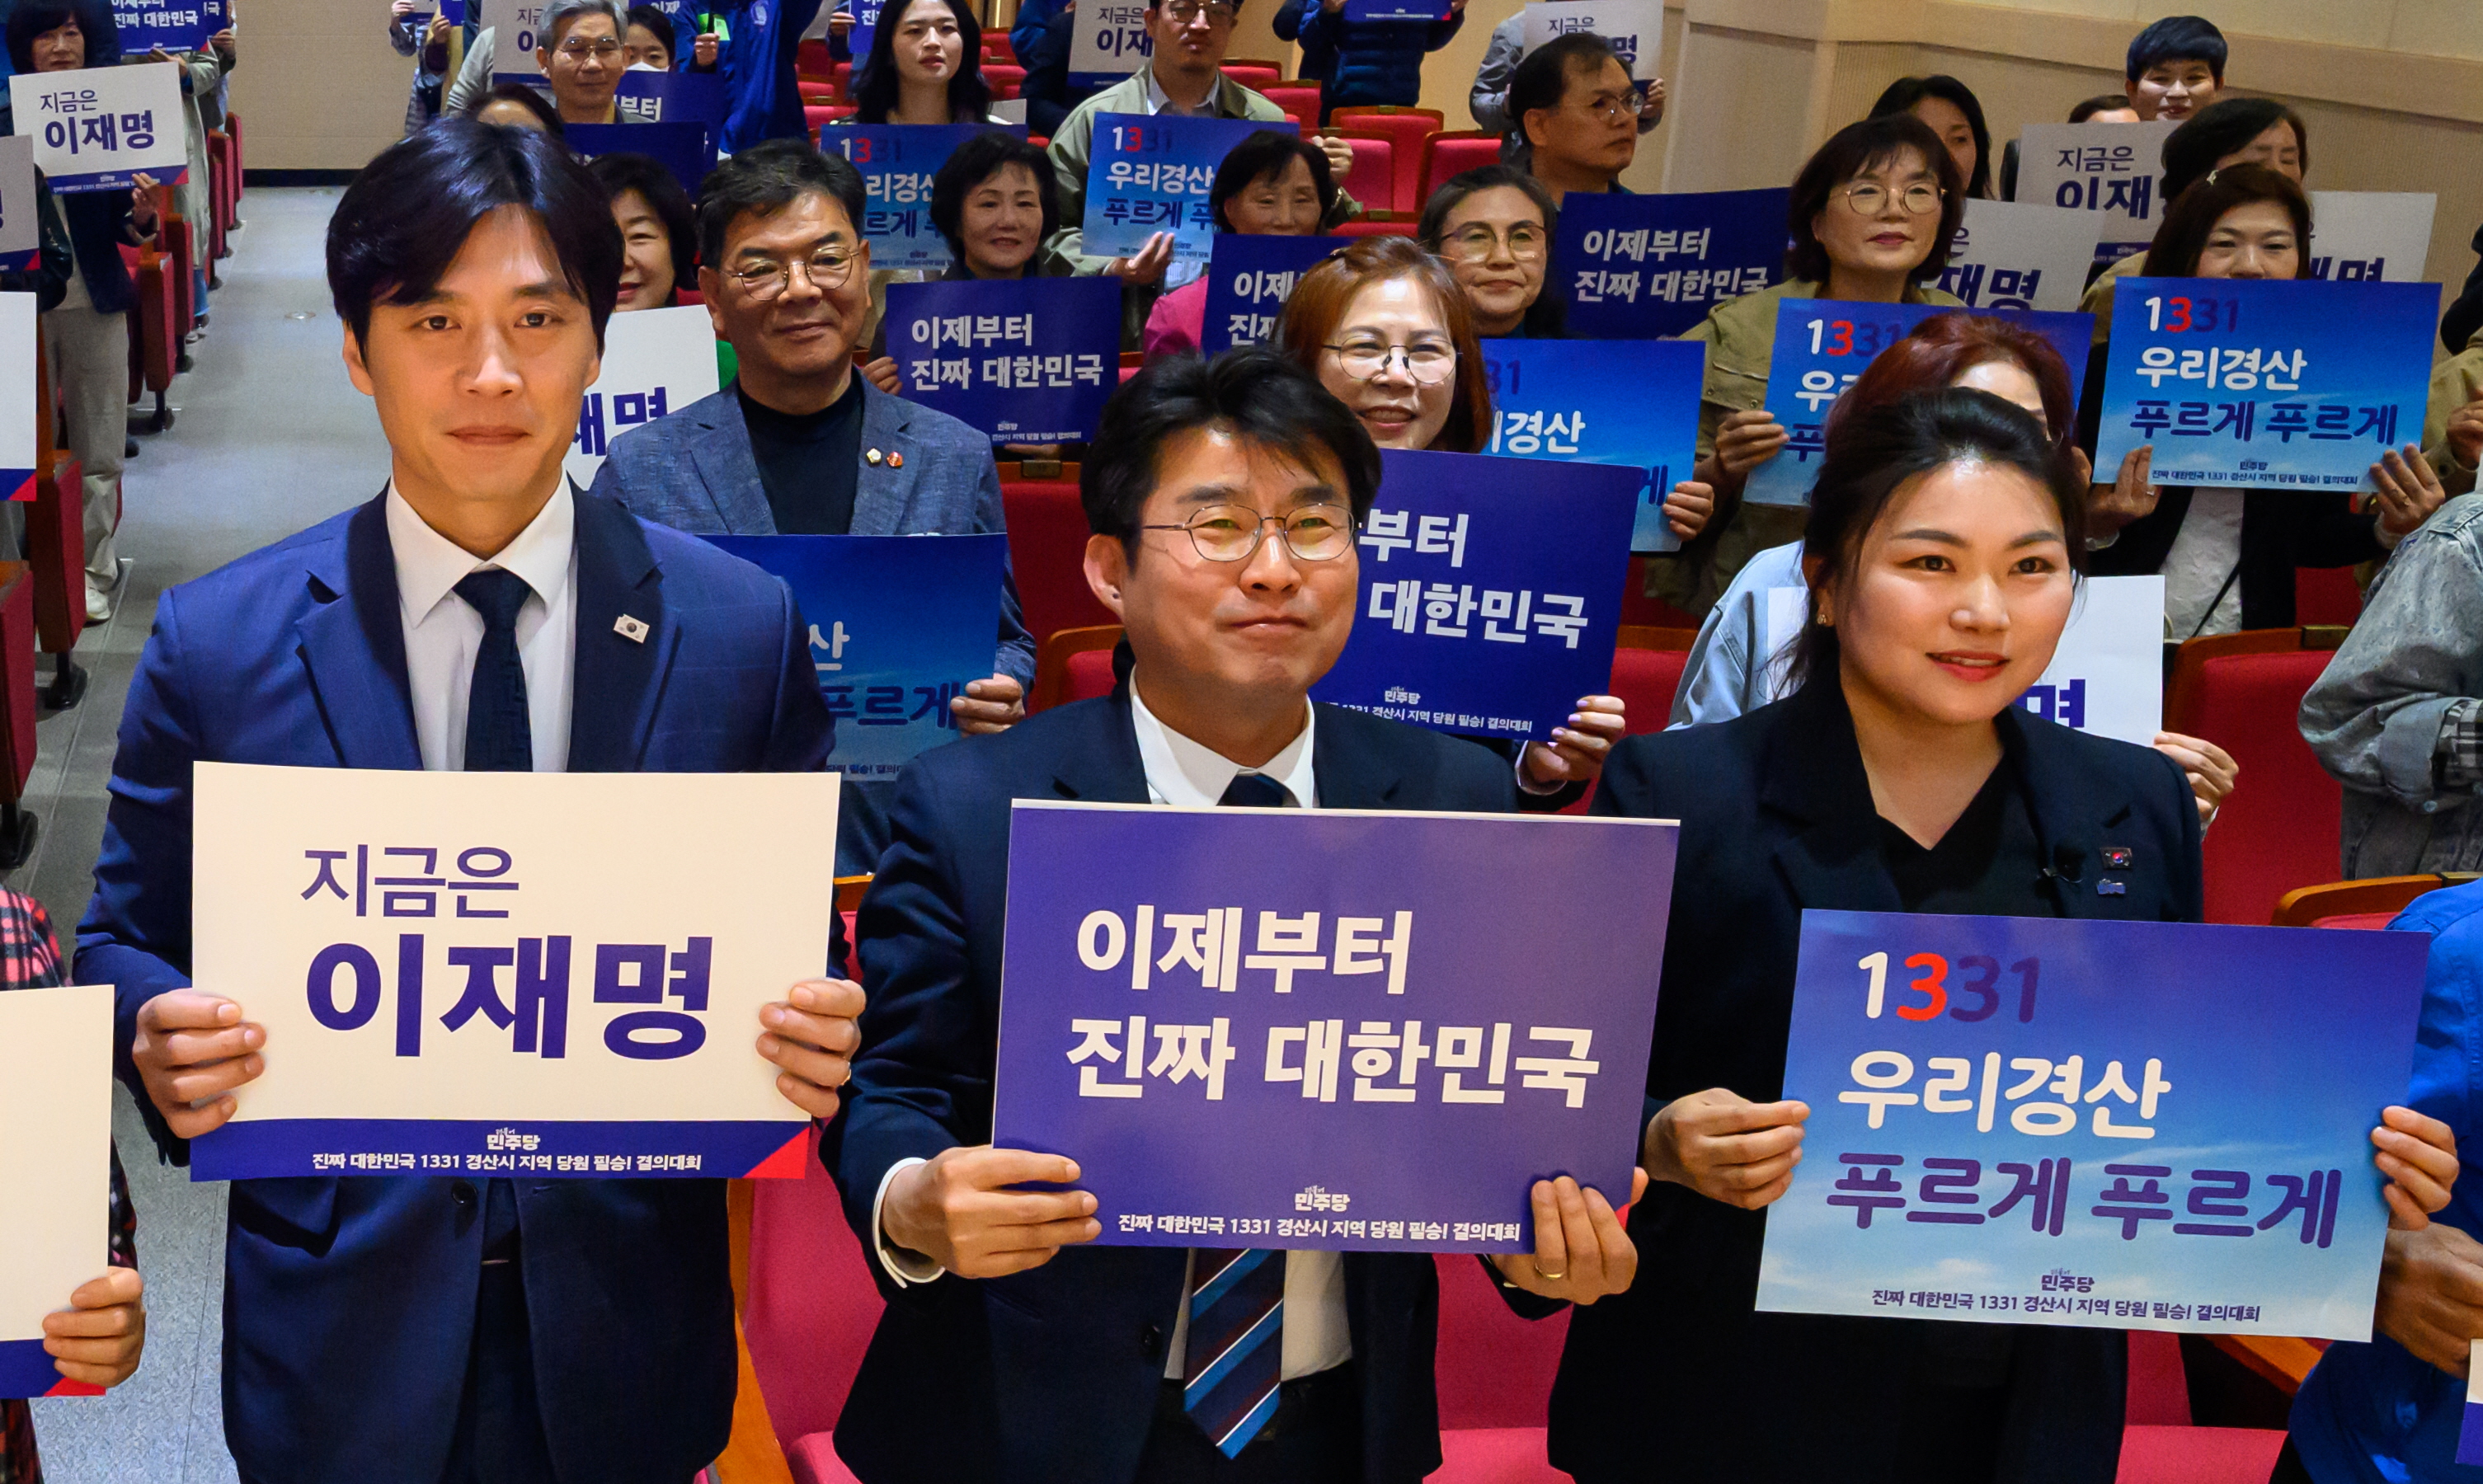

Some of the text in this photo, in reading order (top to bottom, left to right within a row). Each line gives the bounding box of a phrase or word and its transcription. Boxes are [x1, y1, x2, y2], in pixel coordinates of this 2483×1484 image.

[113, 10, 199, 28] 진짜 대한민국
[862, 10, 881, 26] 진
[1098, 7, 1145, 25] 지금은
[1549, 16, 1595, 35] 지금은
[40, 89, 98, 113] 지금은
[614, 95, 661, 121] 부터
[45, 110, 155, 154] 이재명
[1112, 126, 1172, 153] 1331
[2057, 146, 2134, 171] 지금은
[1107, 161, 1215, 195] 우리경산
[1103, 198, 1183, 229] 푸르게
[2056, 176, 2152, 219] 이재
[1583, 228, 1711, 262] 이제부터
[1234, 270, 1296, 303] 이제
[1575, 267, 1768, 303] 진짜 대한민국
[912, 313, 1032, 349] 이제부터
[2146, 296, 2239, 333] 1331
[910, 355, 1103, 391] 진짜 대한민국
[2136, 347, 2307, 391] 우리경산
[1795, 370, 1859, 412] 우
[2130, 400, 2398, 446] 푸르게 푸르게
[1359, 509, 1470, 568] 부터
[1368, 580, 1588, 649] 대한민국
[1384, 690, 1421, 705] 민주당
[1407, 710, 1430, 723] 지역
[1432, 712, 1455, 726] 당원
[1487, 717, 1532, 732] 결의대회
[300, 843, 519, 918] 지금은
[1076, 904, 1413, 994] 이제부터
[306, 933, 712, 1060] 이재명
[1858, 951, 2041, 1024] 1331
[1066, 1015, 1600, 1107] 진짜 대한민국
[1838, 1050, 2172, 1139] 우리경산
[487, 1134, 541, 1151] 민주당
[313, 1153, 702, 1171] 진짜 대한민국 1331 경산시 지역 당원 필승! 결의대회
[1295, 1193, 1351, 1212] 민주당
[1827, 1152, 2342, 1249] 푸르게 푸르게
[1118, 1214, 1521, 1242] 진짜 대한민국 1331 경산시 지역 당원 필승! 결의대회
[2041, 1275, 2095, 1294] 민주당
[1872, 1289, 2261, 1322] 진짜 대한민국 1331 경산시 지역 당원 필승! 결의대회
